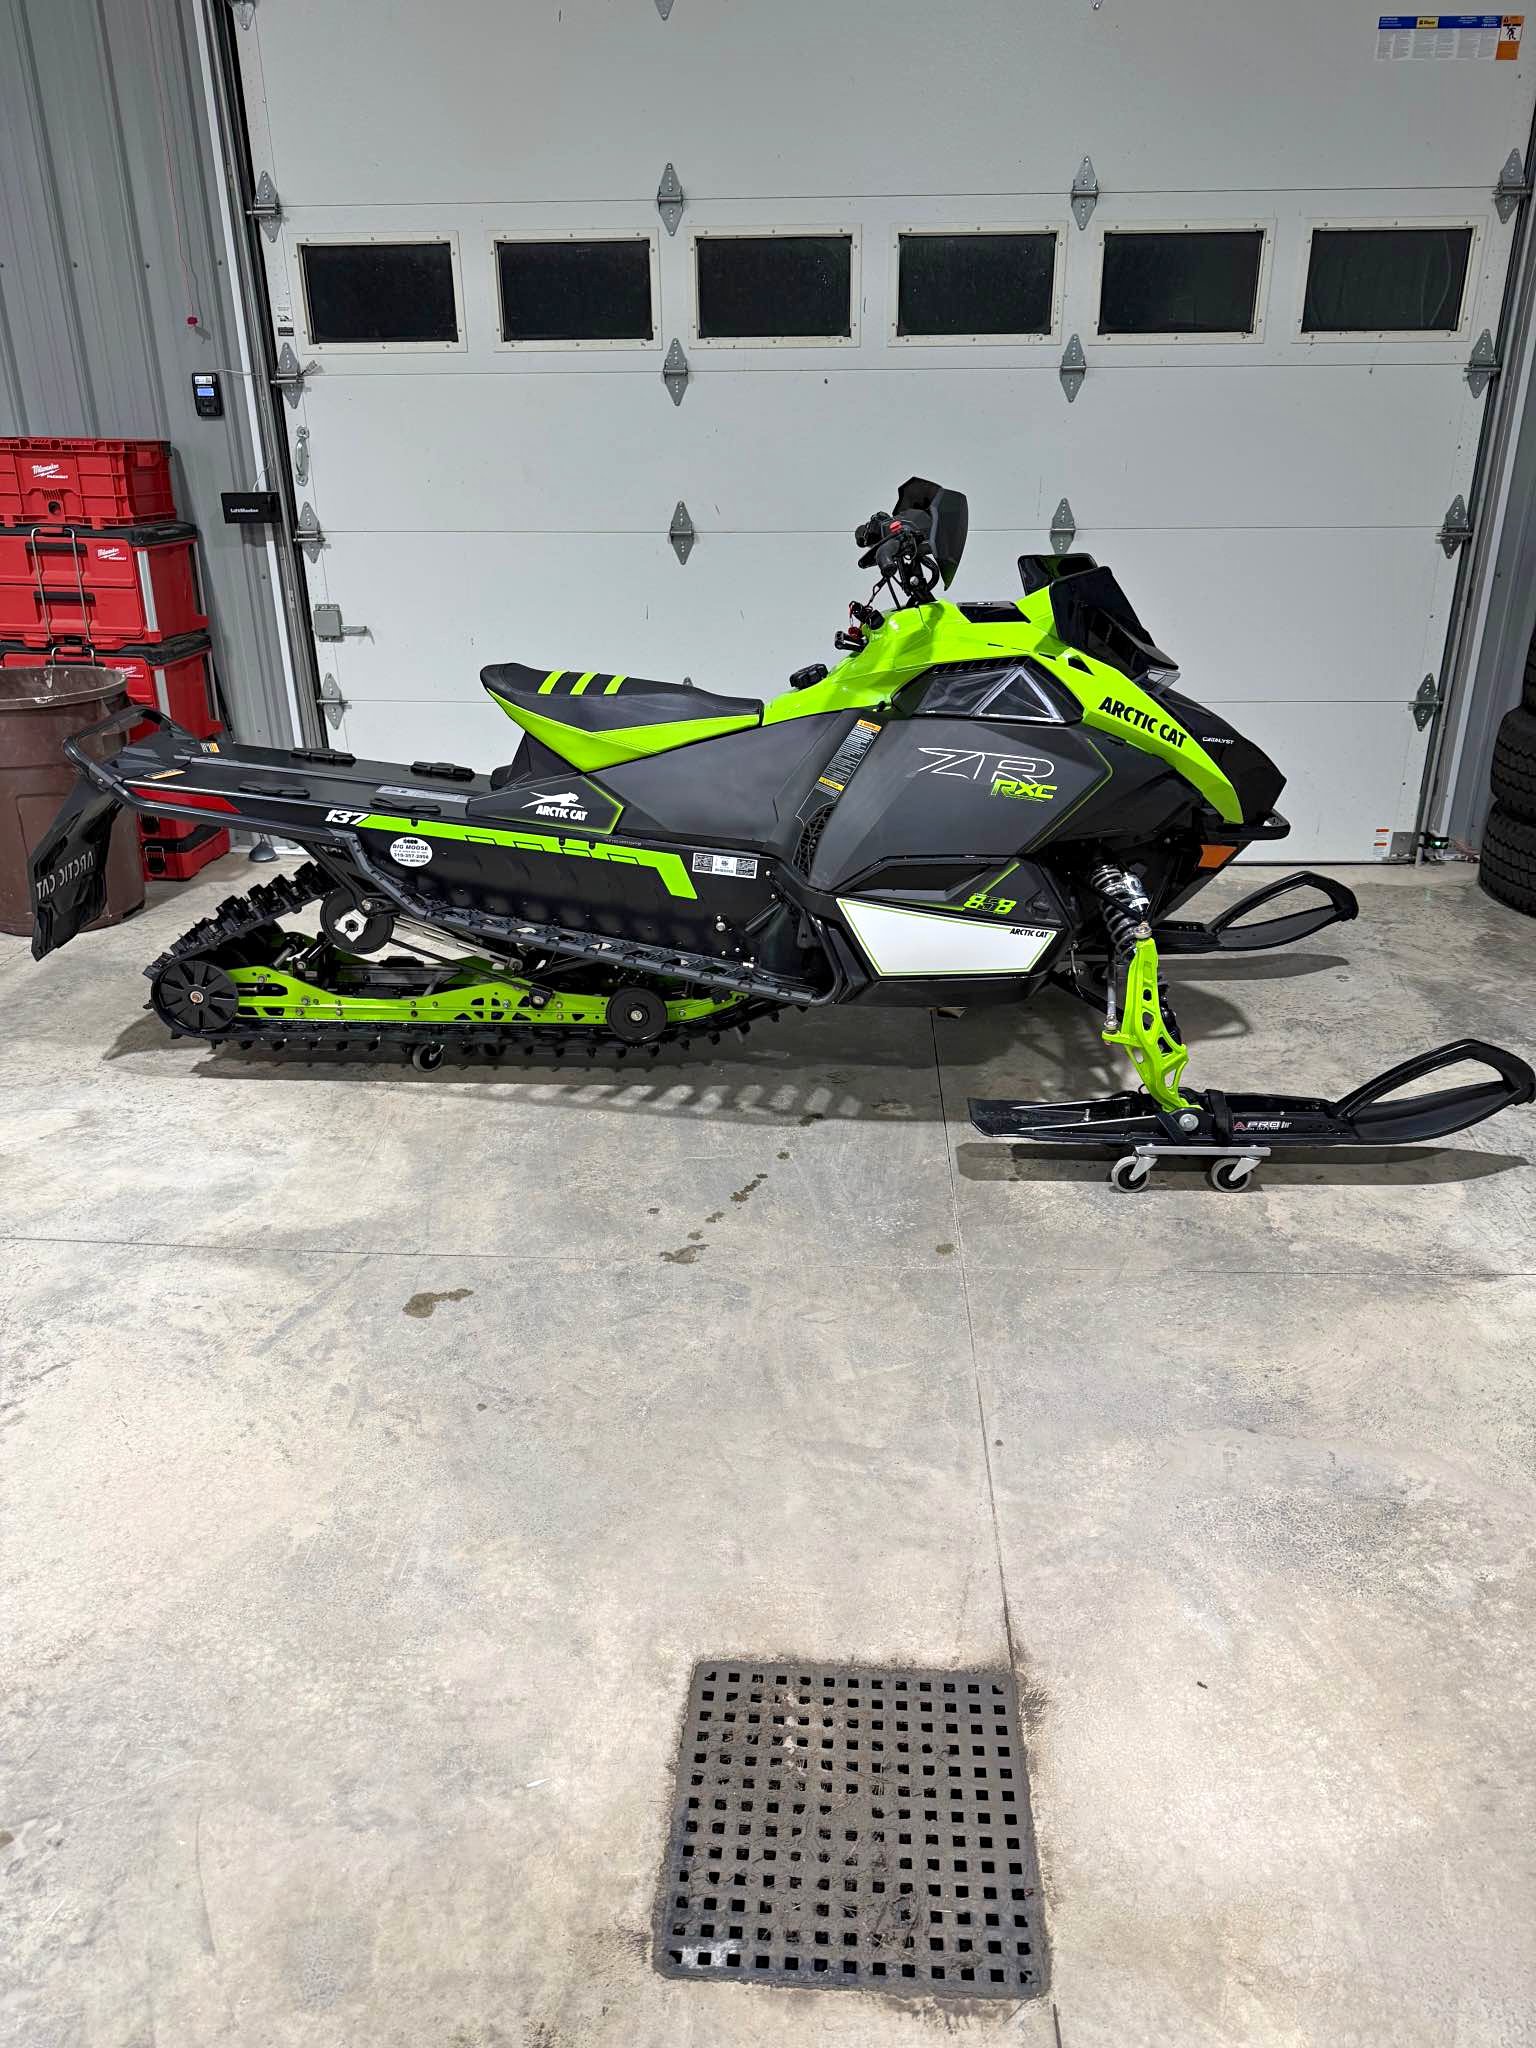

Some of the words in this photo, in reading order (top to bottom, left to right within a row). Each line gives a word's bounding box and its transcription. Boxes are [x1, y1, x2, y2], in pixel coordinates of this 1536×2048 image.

[1098, 696, 1158, 734] ARCTIC
[1159, 724, 1187, 748] CAT
[1202, 736, 1234, 745] CATALYST
[991, 779, 1058, 800] RXC
[325, 809, 371, 826] 137
[536, 805, 569, 818] ARCTIC
[570, 811, 588, 821] CAT
[1010, 928, 1035, 938] ARCTIC
[1035, 930, 1049, 938] CAT
